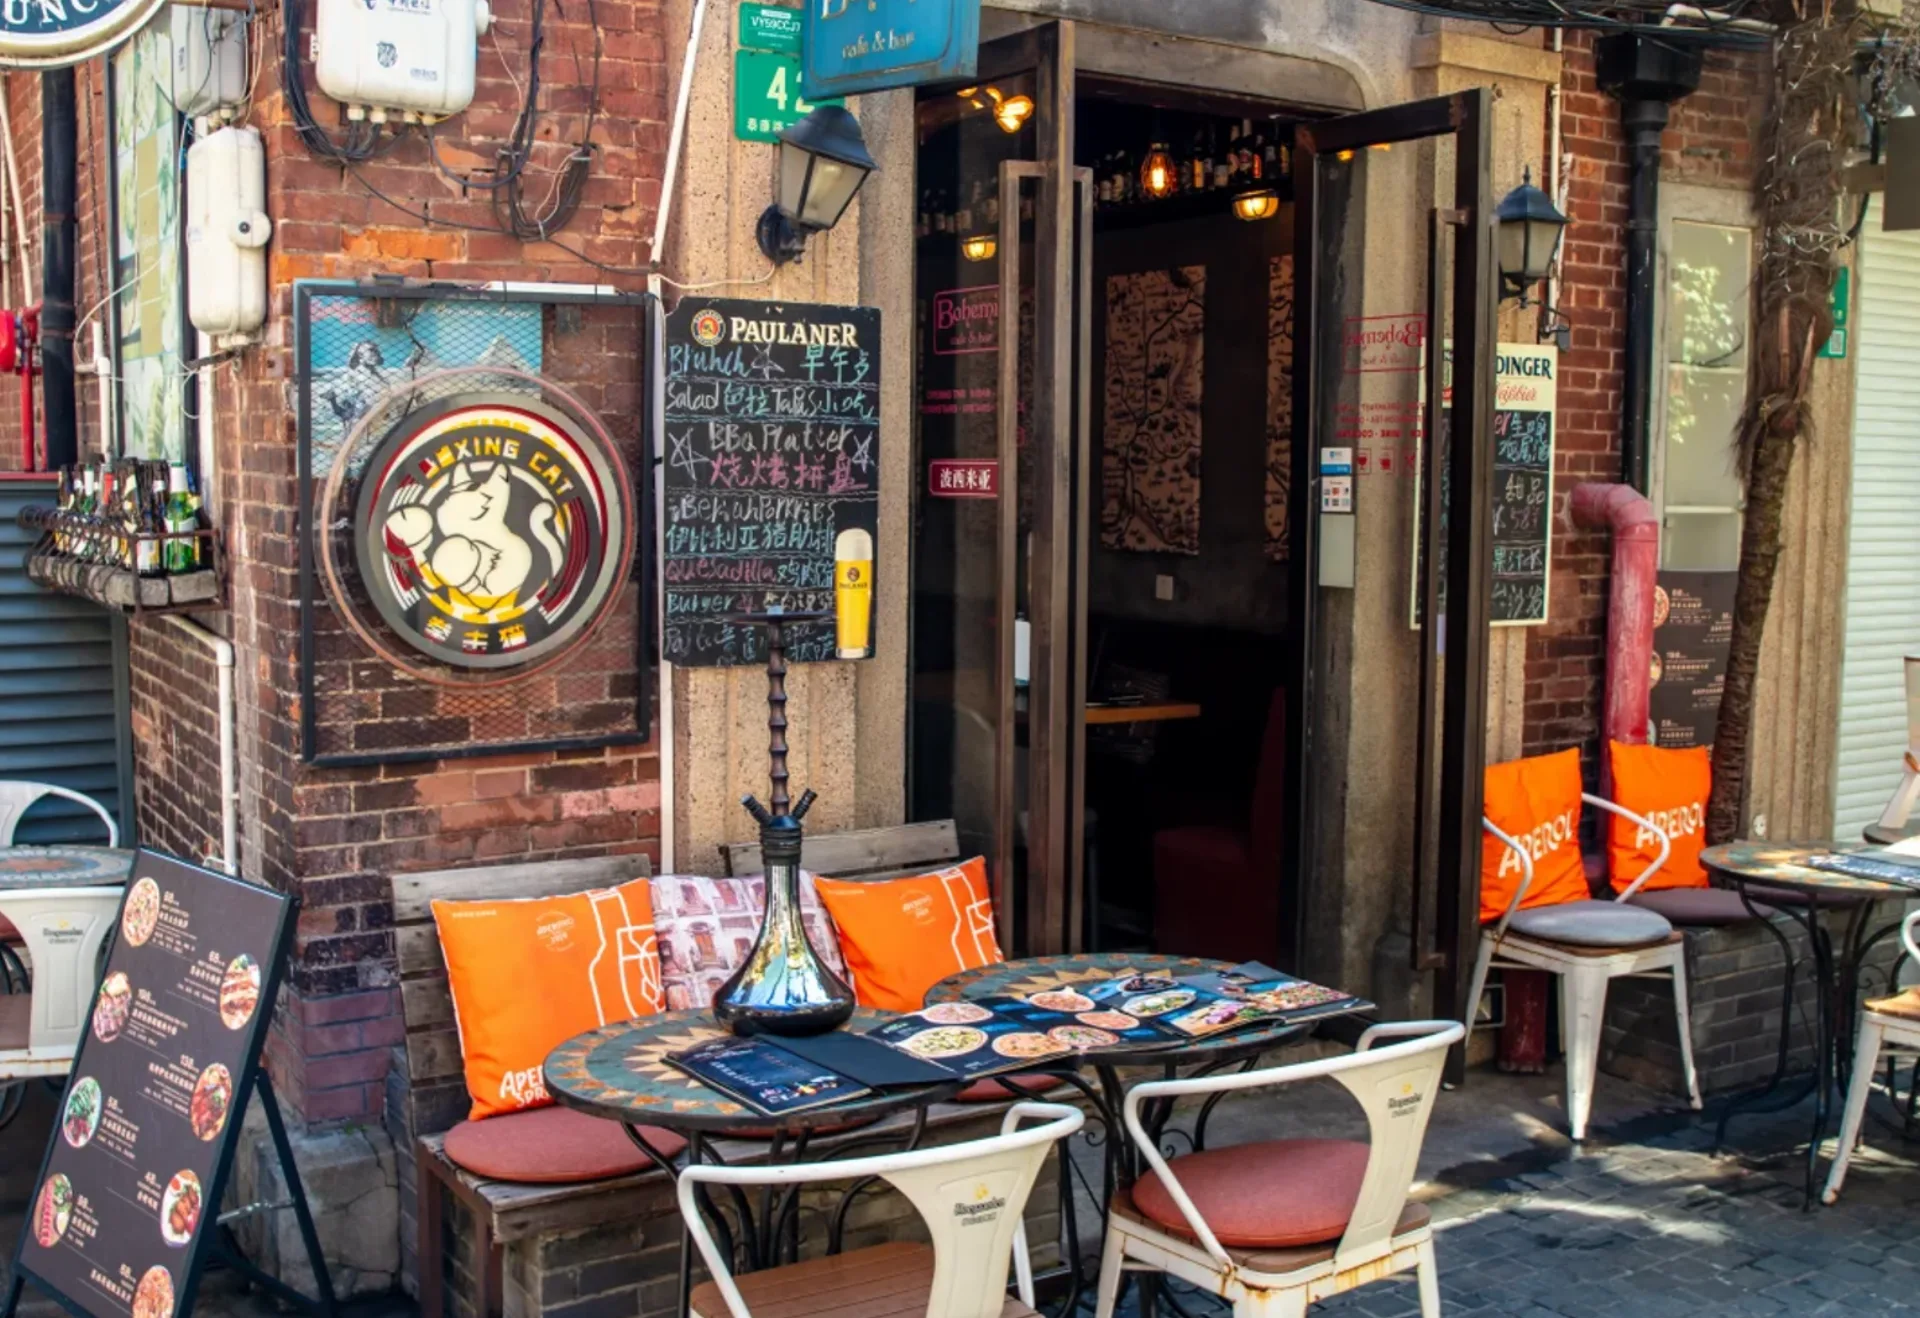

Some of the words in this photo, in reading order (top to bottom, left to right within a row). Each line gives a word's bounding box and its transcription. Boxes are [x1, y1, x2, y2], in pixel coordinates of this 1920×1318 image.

[871, 30, 885, 53] &
[730, 316, 858, 348] PAULANER
[1496, 355, 1552, 380] DINGER
[666, 381, 720, 410] Salad
[527, 449, 575, 496] CAT
[664, 557, 776, 583] Quesadilla
[666, 592, 735, 614] Burger
[1497, 808, 1574, 878] APEROL
[515, 1086, 552, 1108] SPR
